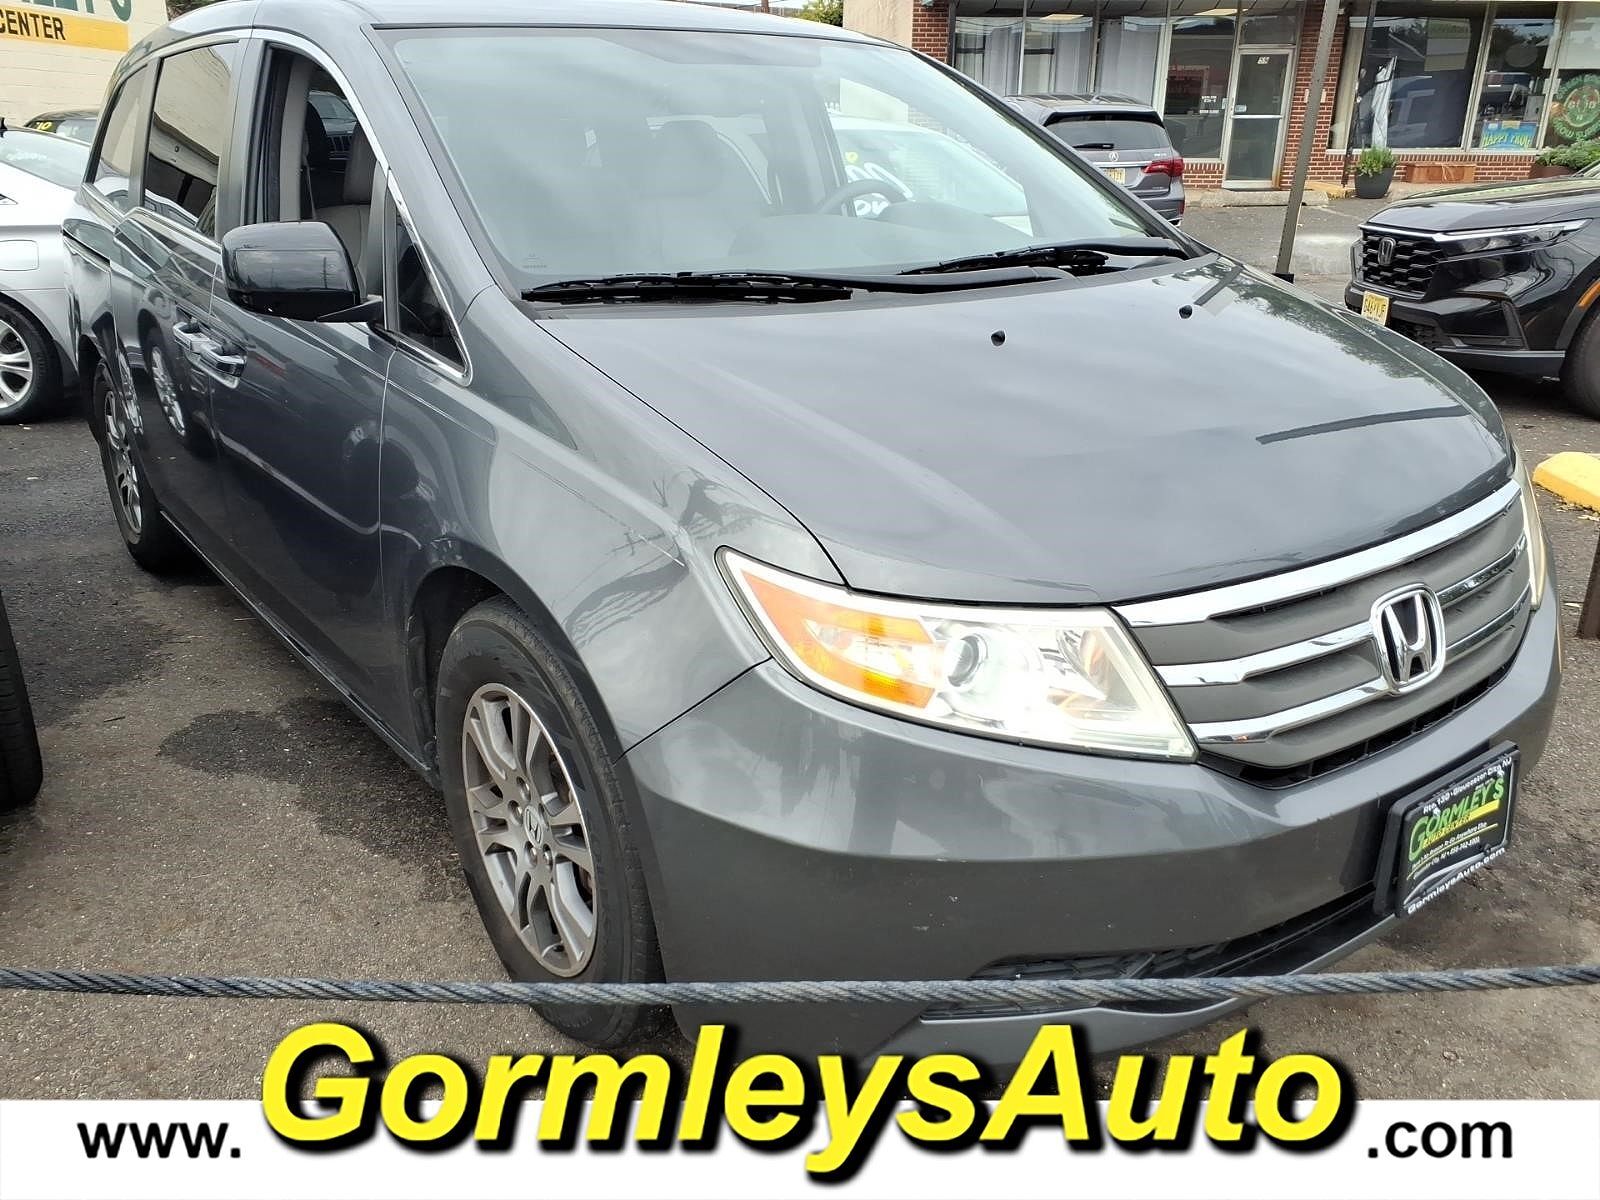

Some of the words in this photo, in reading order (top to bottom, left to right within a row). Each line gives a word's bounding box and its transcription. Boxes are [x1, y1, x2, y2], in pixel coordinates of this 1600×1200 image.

[1452, 772, 1488, 796] Gloucester
[1502, 756, 1512, 768] NJ
[1407, 847, 1506, 915] GormleysAuto.com
